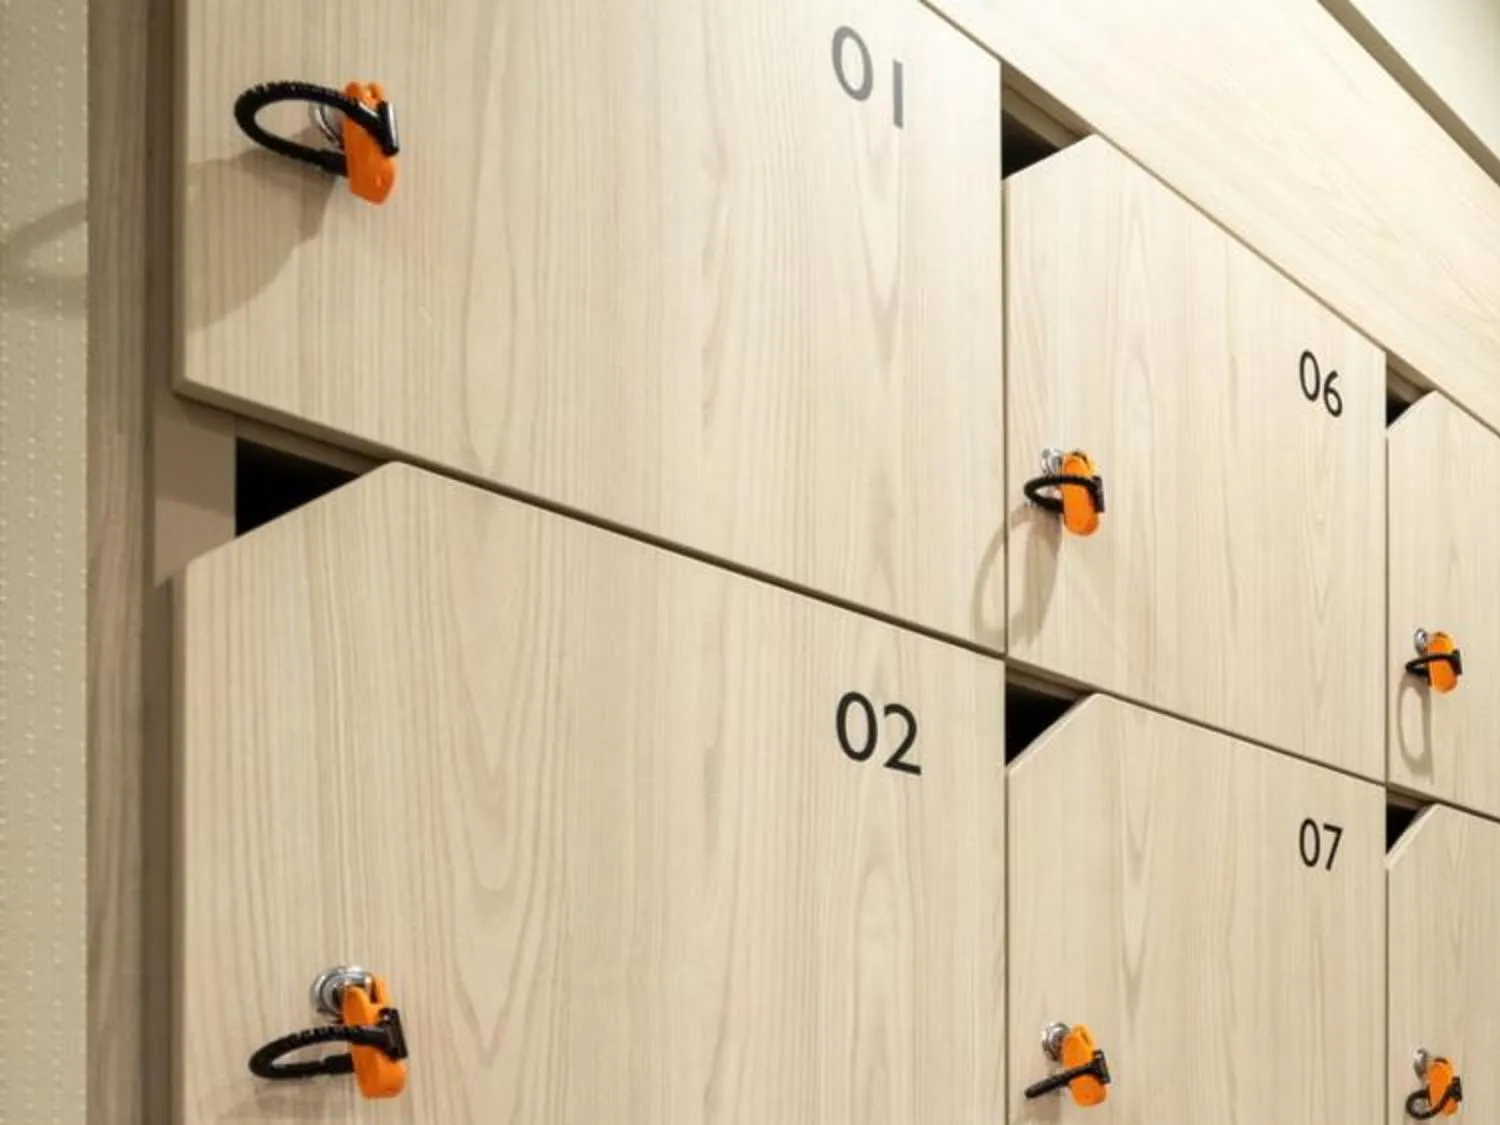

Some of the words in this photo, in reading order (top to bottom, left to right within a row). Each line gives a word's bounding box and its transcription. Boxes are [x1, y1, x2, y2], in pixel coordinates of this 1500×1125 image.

[831, 25, 904, 130] 01
[1299, 350, 1343, 418] 06
[835, 691, 922, 776] 02
[1299, 817, 1343, 871] 07
